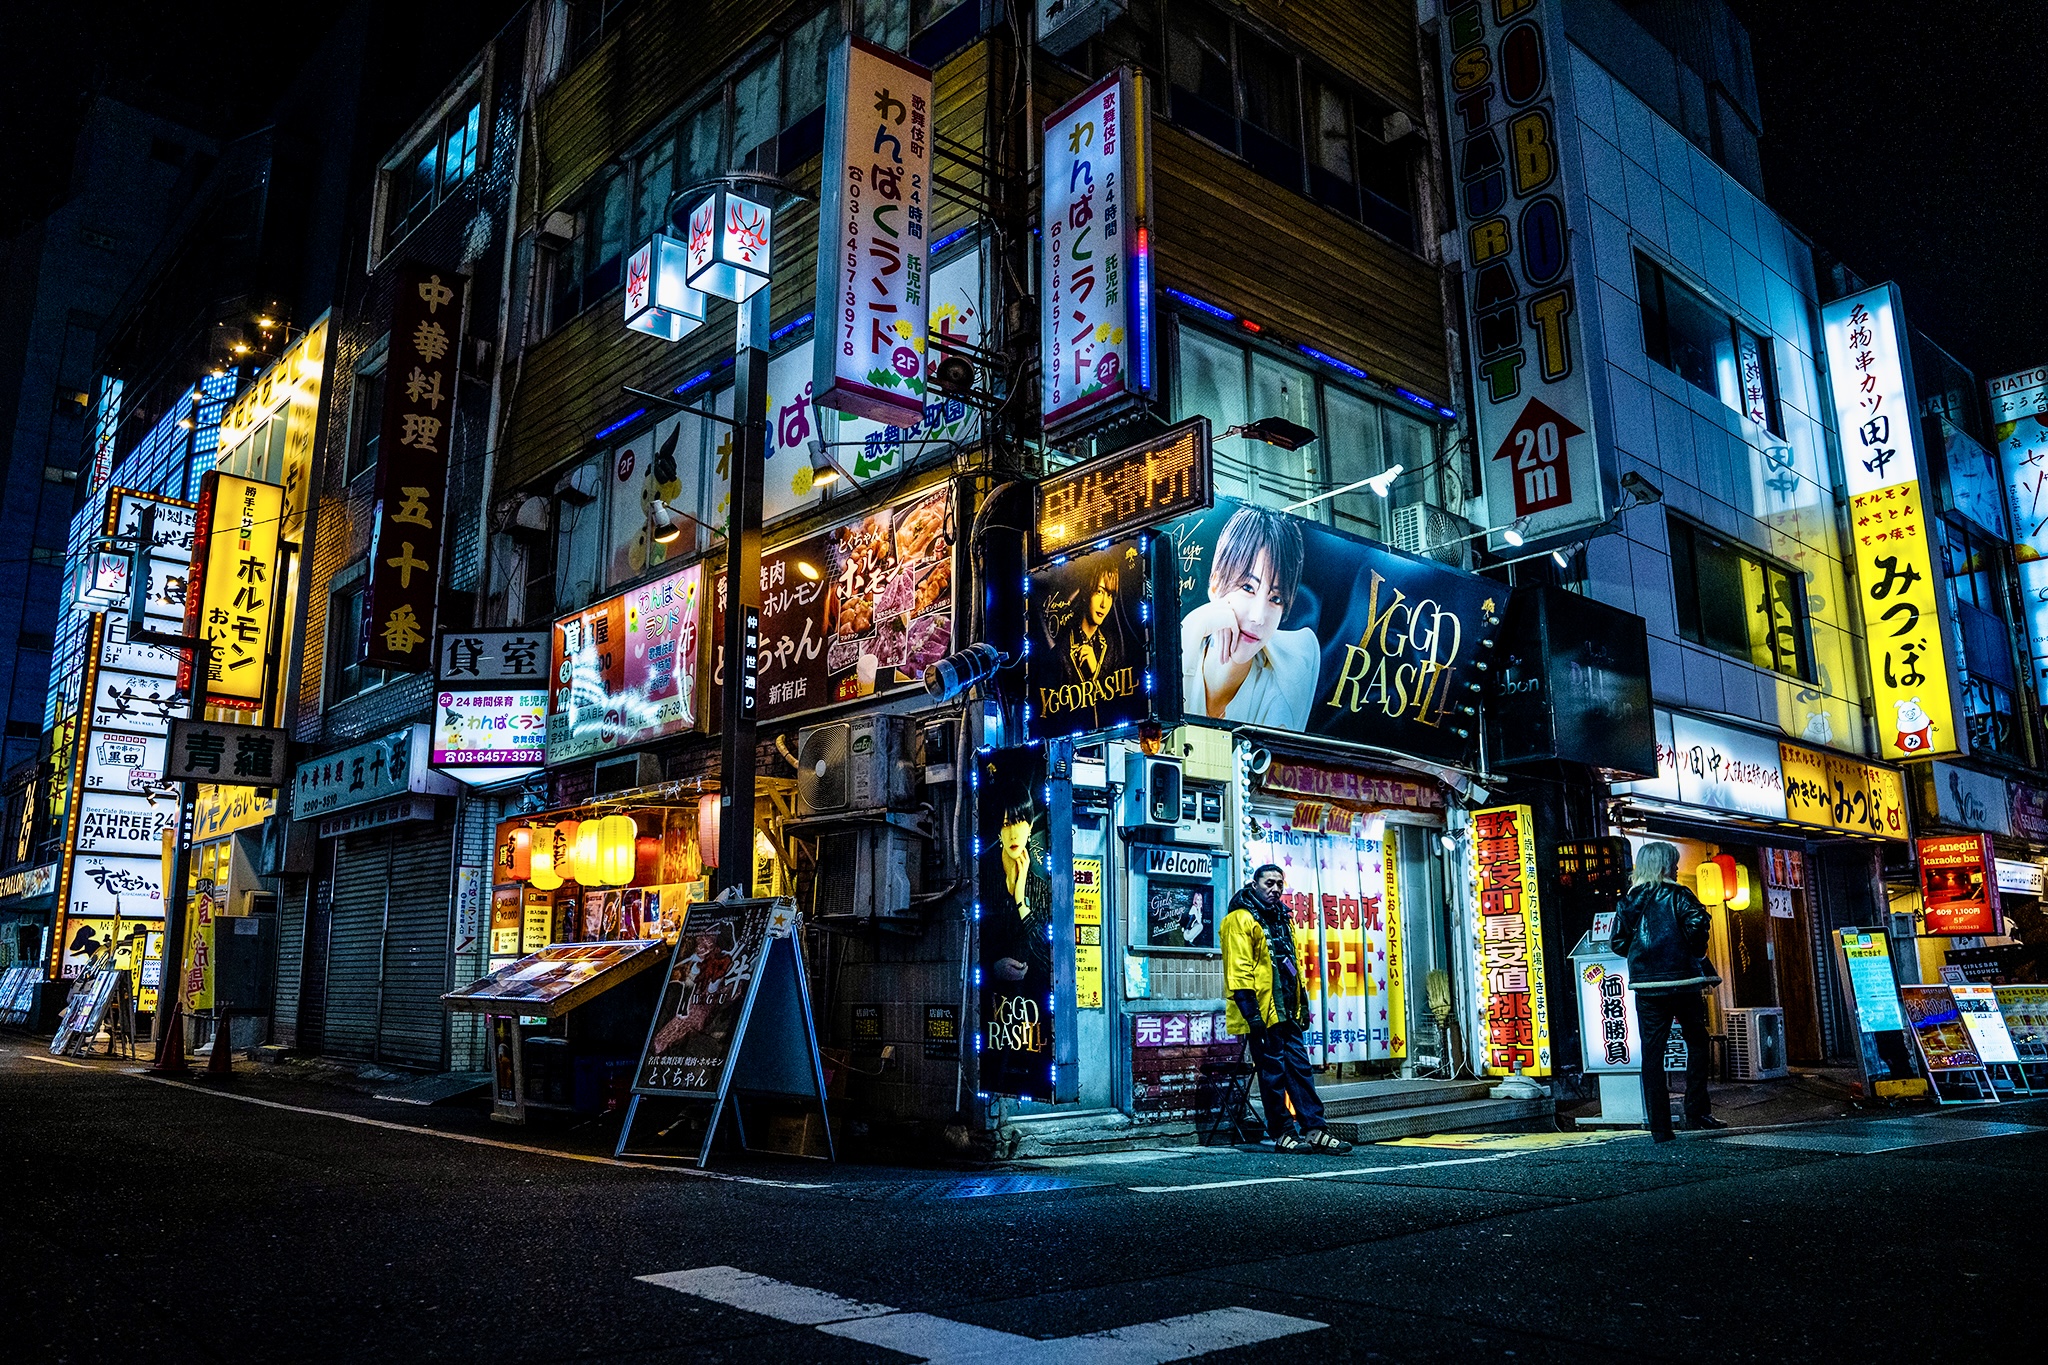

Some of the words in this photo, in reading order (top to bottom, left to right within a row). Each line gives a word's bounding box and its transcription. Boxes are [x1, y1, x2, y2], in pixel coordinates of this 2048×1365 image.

[910, 93, 926, 159] 歌舞伎町
[1102, 92, 1116, 156] 歌舞伎町
[907, 174, 923, 240] 24時間
[1104, 172, 1117, 241] 24時間
[1443, 0, 1527, 404] ESTAURANT
[1493, 0, 1573, 384] OBOT
[868, 87, 907, 355] わんぱくランド
[843, 184, 861, 357] 03-6457-3978
[1068, 122, 1096, 386] わんぱくランド
[905, 252, 922, 307] 託児所
[1105, 252, 1118, 308] 託児所
[1050, 237, 1061, 405] 03-6457-3978
[400, 274, 455, 454] 中華料理
[896, 353, 916, 370] 2F
[1100, 359, 1116, 377] 2F
[1847, 302, 1897, 480] 名物串カツ田中
[1992, 369, 2047, 394] PIATTO
[619, 453, 635, 475] 2F
[1514, 422, 1561, 471] 20
[1525, 465, 1558, 505] m
[1854, 486, 1911, 509] ホルモン
[1857, 505, 1915, 528] やきとん
[1860, 524, 1918, 547] もつ焼き
[838, 525, 882, 555] とくちゃん
[380, 486, 433, 653] 五十番
[836, 548, 905, 600] ホルモン
[228, 555, 266, 672] ホルモン
[638, 577, 686, 616] わんぱく
[763, 579, 825, 618] ホルモン
[644, 607, 680, 641] ランド
[1357, 568, 1462, 674] YGGD
[1870, 554, 1928, 691] みつぼ
[104, 653, 120, 664] 5F
[207, 607, 230, 683] おいで屋
[446, 636, 540, 678] 貸室
[713, 616, 824, 687] とちゃん
[744, 615, 758, 709] 仲見世通り
[440, 696, 452, 704] 2F
[456, 697, 470, 707] 24
[472, 696, 514, 708] 時間保育
[519, 695, 549, 708] 託児所
[768, 677, 808, 706] 新宿店
[1039, 666, 1140, 719] YGGDRASILL
[95, 715, 112, 726] 4F
[467, 713, 549, 731] わんぱくラン
[852, 721, 874, 732] TOSHIBA
[108, 751, 139, 764] 黒田
[87, 775, 104, 787] 3F
[1786, 775, 1832, 808] やきとん
[84, 812, 153, 829] ATHREE
[1293, 802, 1323, 829] SALE
[1326, 806, 1354, 833] SALE
[1834, 775, 1885, 834] みつぼ
[80, 838, 97, 849] 2F
[82, 825, 151, 842] PARLOR
[1939, 840, 1979, 853] anegirl
[85, 858, 105, 866] つきじ
[1075, 870, 1094, 885] 注意
[1150, 849, 1212, 874] Welcome
[1923, 856, 1962, 866] karaoke
[1963, 855, 1980, 863] bar
[73, 901, 89, 912] 1F
[467, 868, 480, 935] わんぱくランド
[1384, 843, 1400, 988] ご自由にお入り下さい。
[1474, 810, 1536, 1073] 歌舞伎町最安値挑戦中
[1521, 813, 1549, 1040] 18歳未満の方はご入場できません
[1298, 939, 1377, 1000] 報王
[1599, 975, 1630, 1064] 価格勝負
[648, 1066, 709, 1088] とくちゃん
